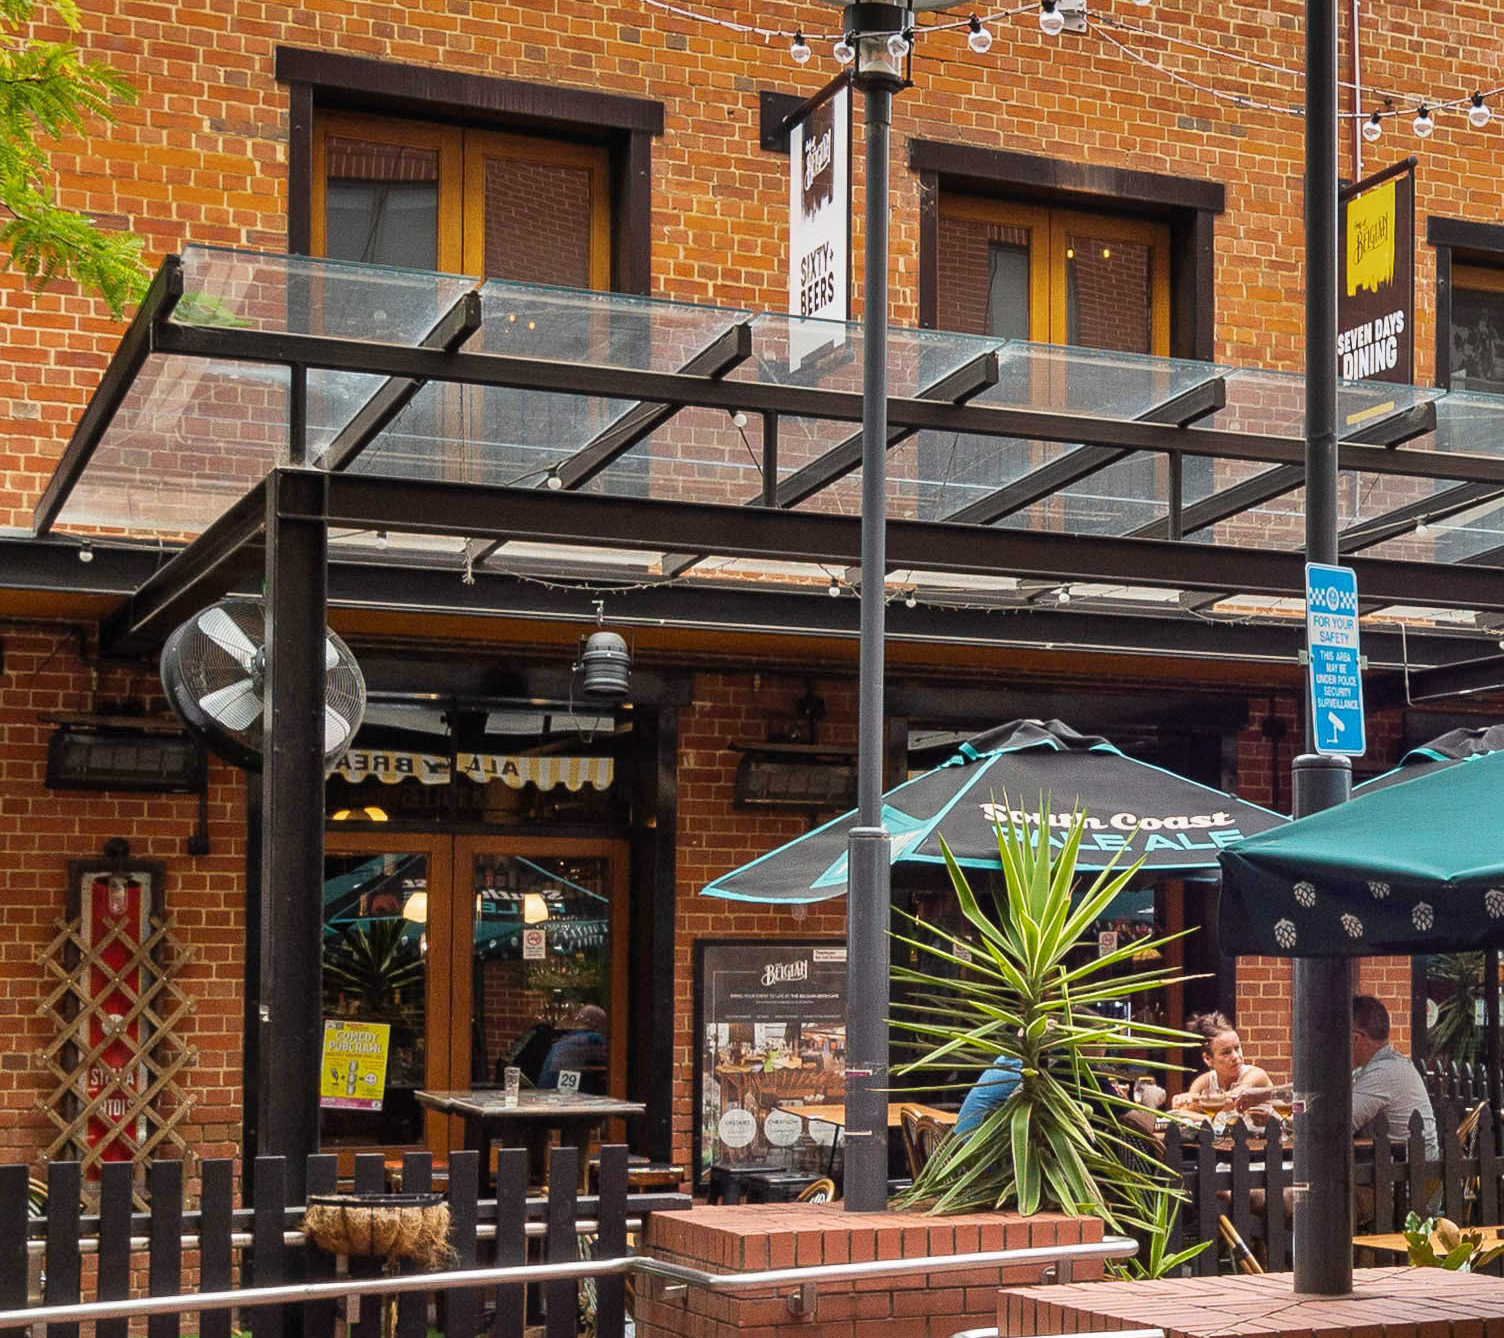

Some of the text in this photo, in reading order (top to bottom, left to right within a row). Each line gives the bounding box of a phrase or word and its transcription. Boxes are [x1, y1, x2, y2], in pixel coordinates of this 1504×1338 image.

[801, 271, 834, 323] BEERS
[1337, 310, 1405, 355] SEVEN DAYS
[1343, 336, 1397, 385] DINING
[1314, 614, 1354, 631] FOR YOUR
[1319, 630, 1349, 645] SAFETY
[1320, 649, 1351, 662] THIS AREA
[1326, 662, 1337, 673] MAY
[1316, 673, 1357, 687] UNDER POLICE
[1324, 685, 1352, 698] SECURITY
[1318, 697, 1359, 710] SURVEILLANCE
[1110, 811, 1236, 830] Coast
[1144, 828, 1247, 852] ALE
[761, 960, 808, 986] BELGIAN
[337, 1030, 380, 1043] COMEDY
[561, 1073, 577, 1087] 29
